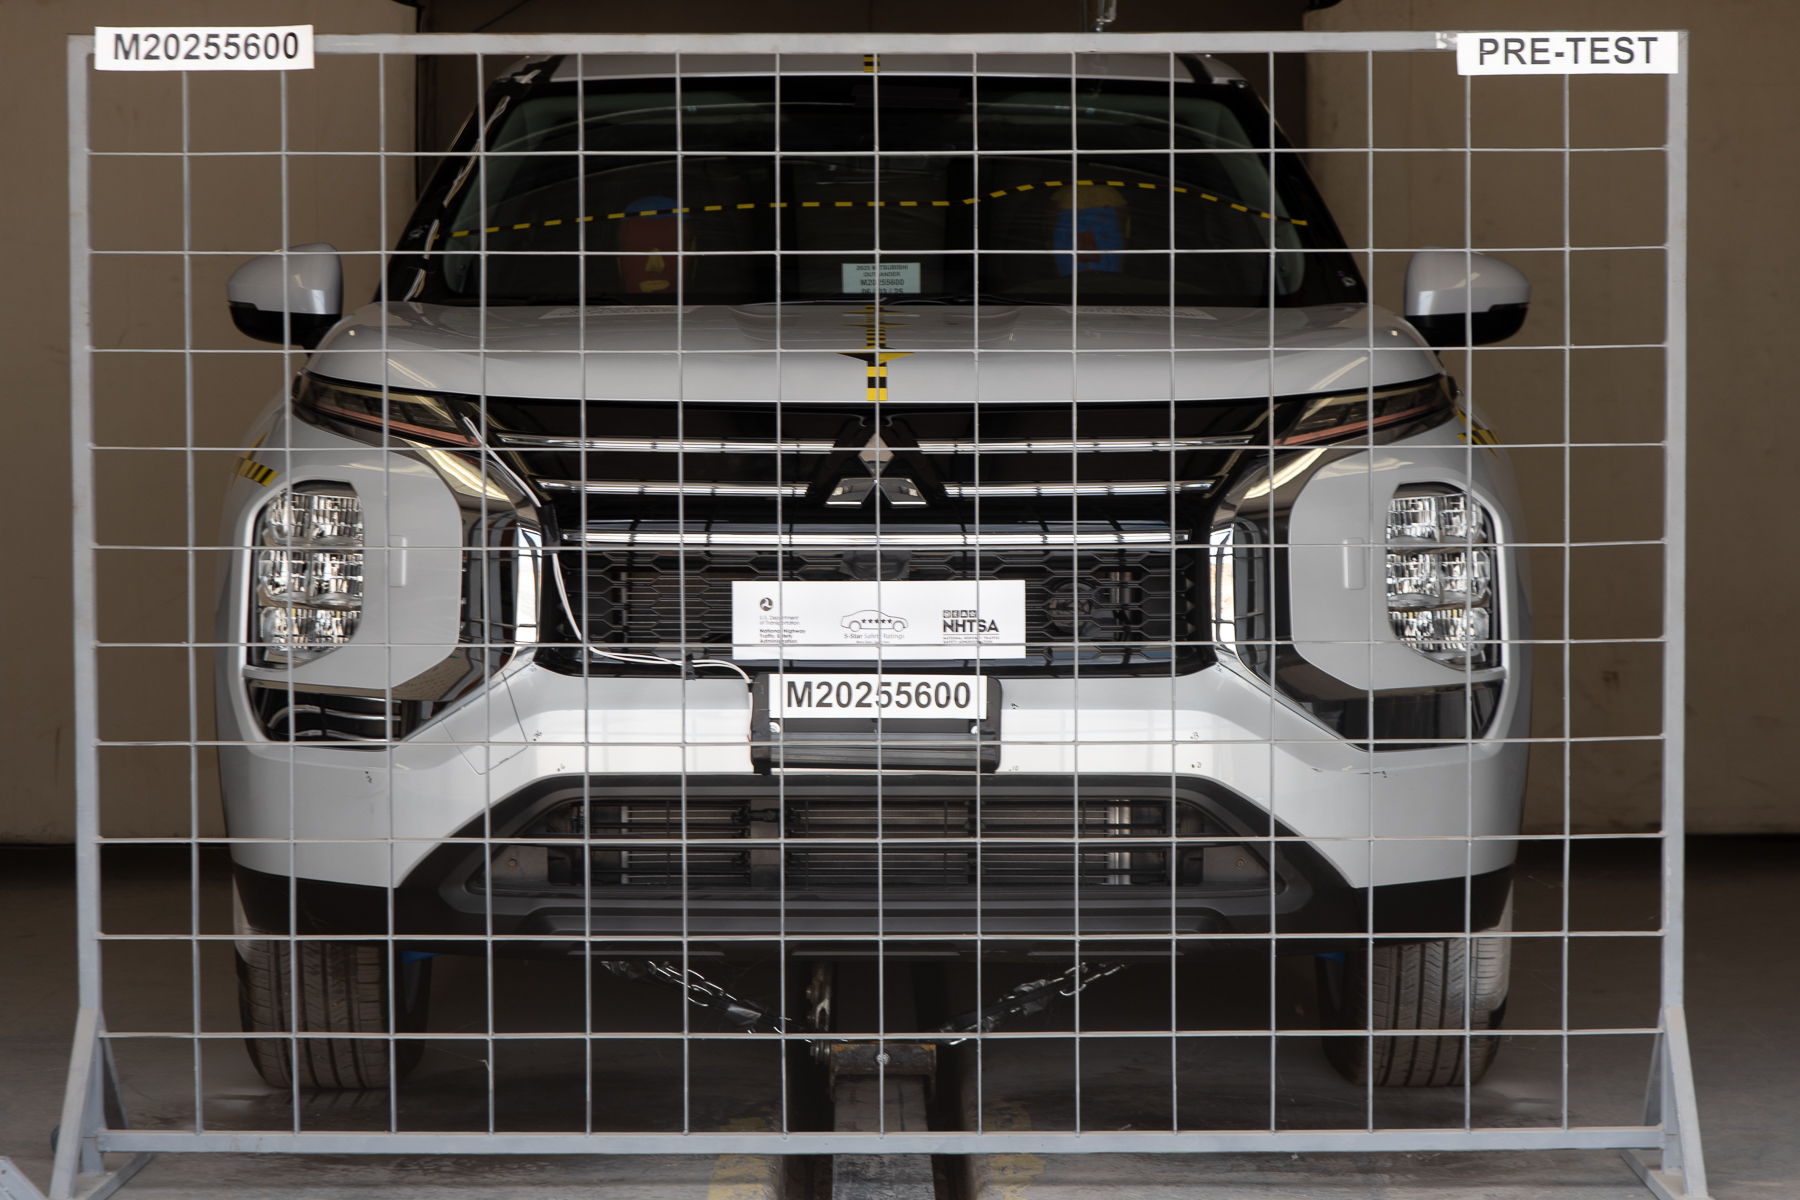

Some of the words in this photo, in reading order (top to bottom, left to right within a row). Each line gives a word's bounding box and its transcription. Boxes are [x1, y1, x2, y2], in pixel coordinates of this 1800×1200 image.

[114, 32, 299, 60] M20255600
[1479, 37, 1658, 65] PRE-TEST
[943, 619, 1000, 632] NHTSA
[787, 681, 971, 708] M20255600
